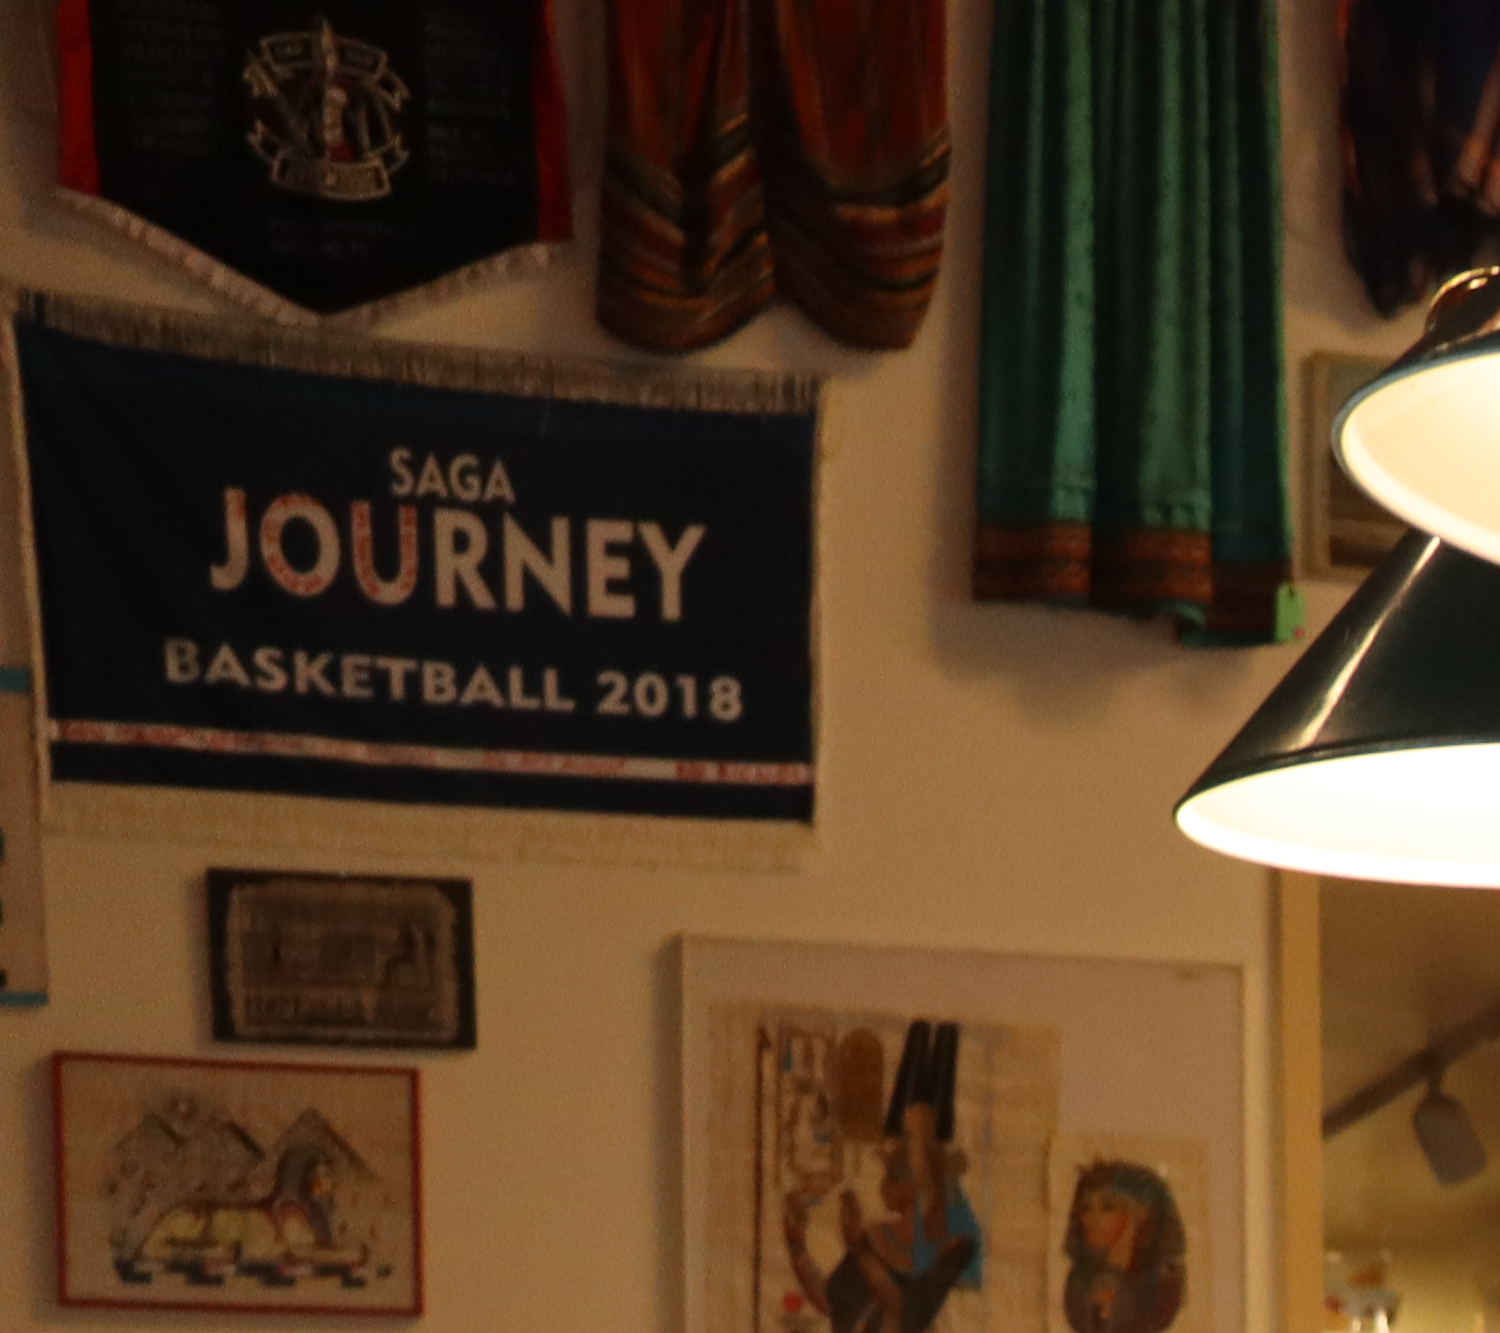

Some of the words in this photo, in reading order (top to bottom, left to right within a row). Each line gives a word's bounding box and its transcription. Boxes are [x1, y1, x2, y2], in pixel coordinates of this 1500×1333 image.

[390, 447, 516, 503] SAGA
[209, 486, 706, 622] JOURNEY
[163, 638, 576, 713] BASKETBALL
[595, 670, 743, 723] 2018
